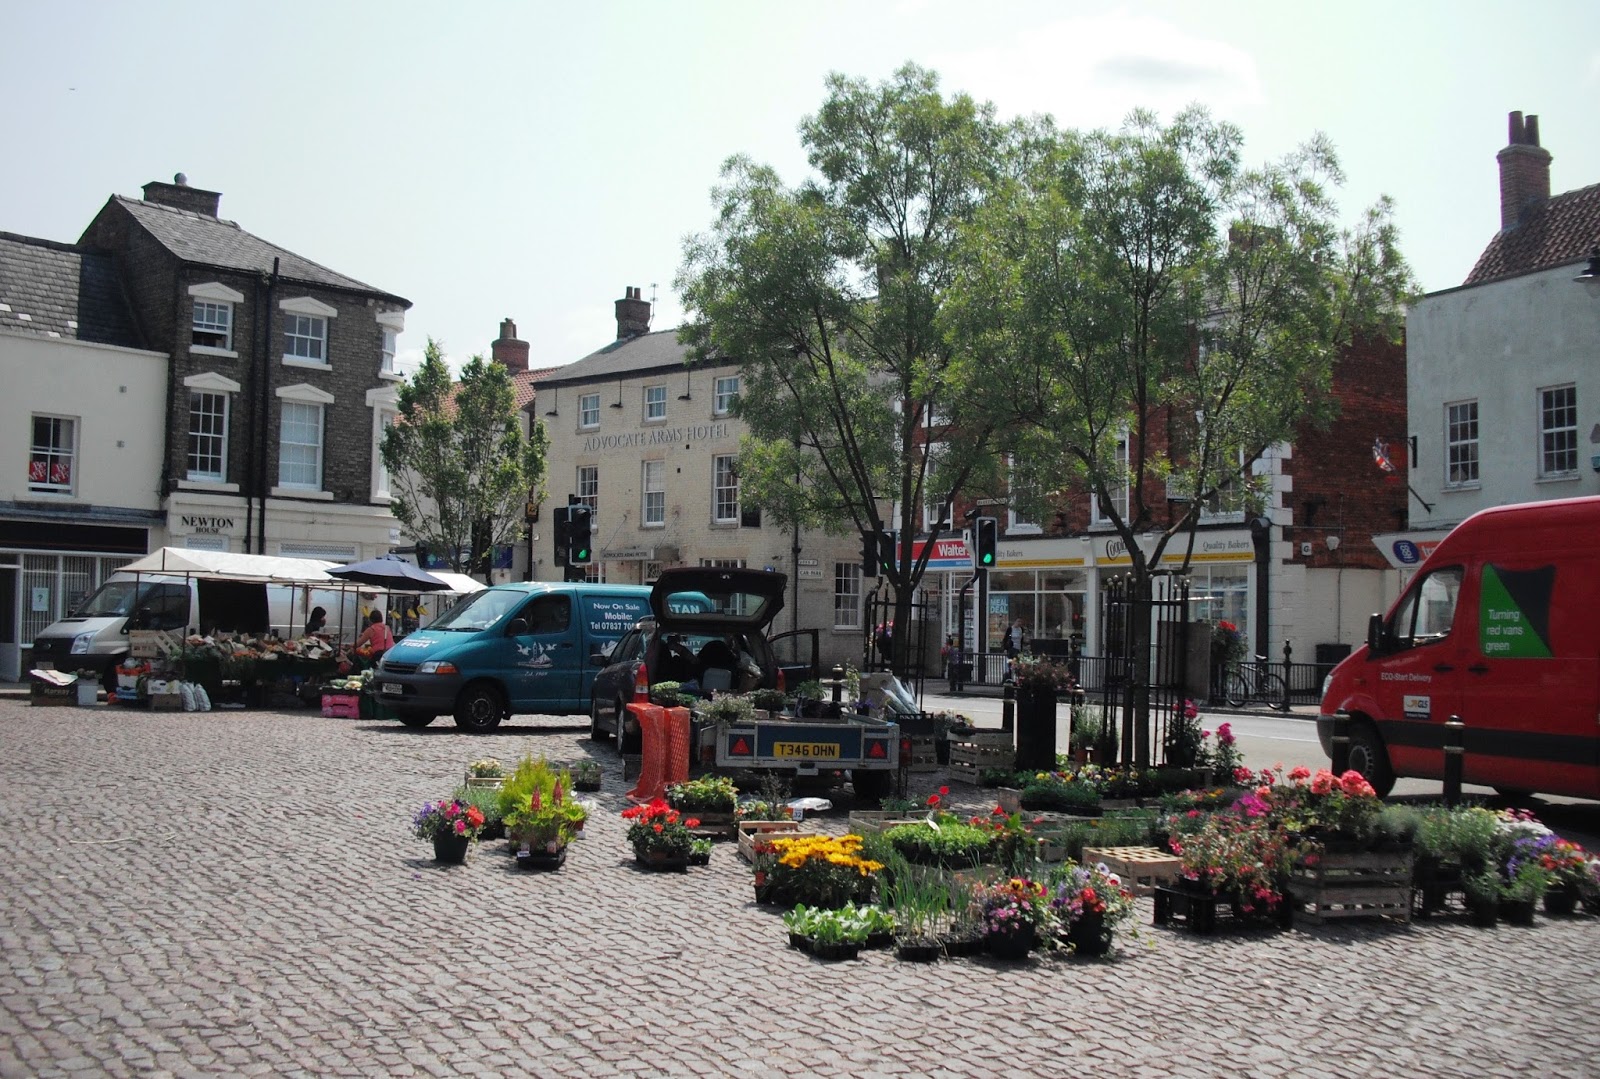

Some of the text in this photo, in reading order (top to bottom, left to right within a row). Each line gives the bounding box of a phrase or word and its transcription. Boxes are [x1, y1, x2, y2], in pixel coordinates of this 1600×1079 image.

[584, 423, 729, 452] ADVOCATE ARMS HOTEL
[181, 515, 234, 528] NEWTON
[1203, 540, 1250, 551] Quality Bakers
[1007, 549, 1023, 558] Bakers
[990, 598, 1008, 606] MEAL
[990, 605, 1008, 614] DEAL
[604, 612, 633, 620] Mobile:
[1488, 609, 1520, 622] Turning
[590, 621, 601, 630] Tel
[601, 622, 622, 630] 07837
[1486, 625, 1523, 636] red vans
[1485, 642, 1510, 654] green
[1381, 672, 1432, 683] ECO-Start Delivery
[1417, 700, 1429, 708] GLS
[779, 744, 836, 756] T346 OHN
